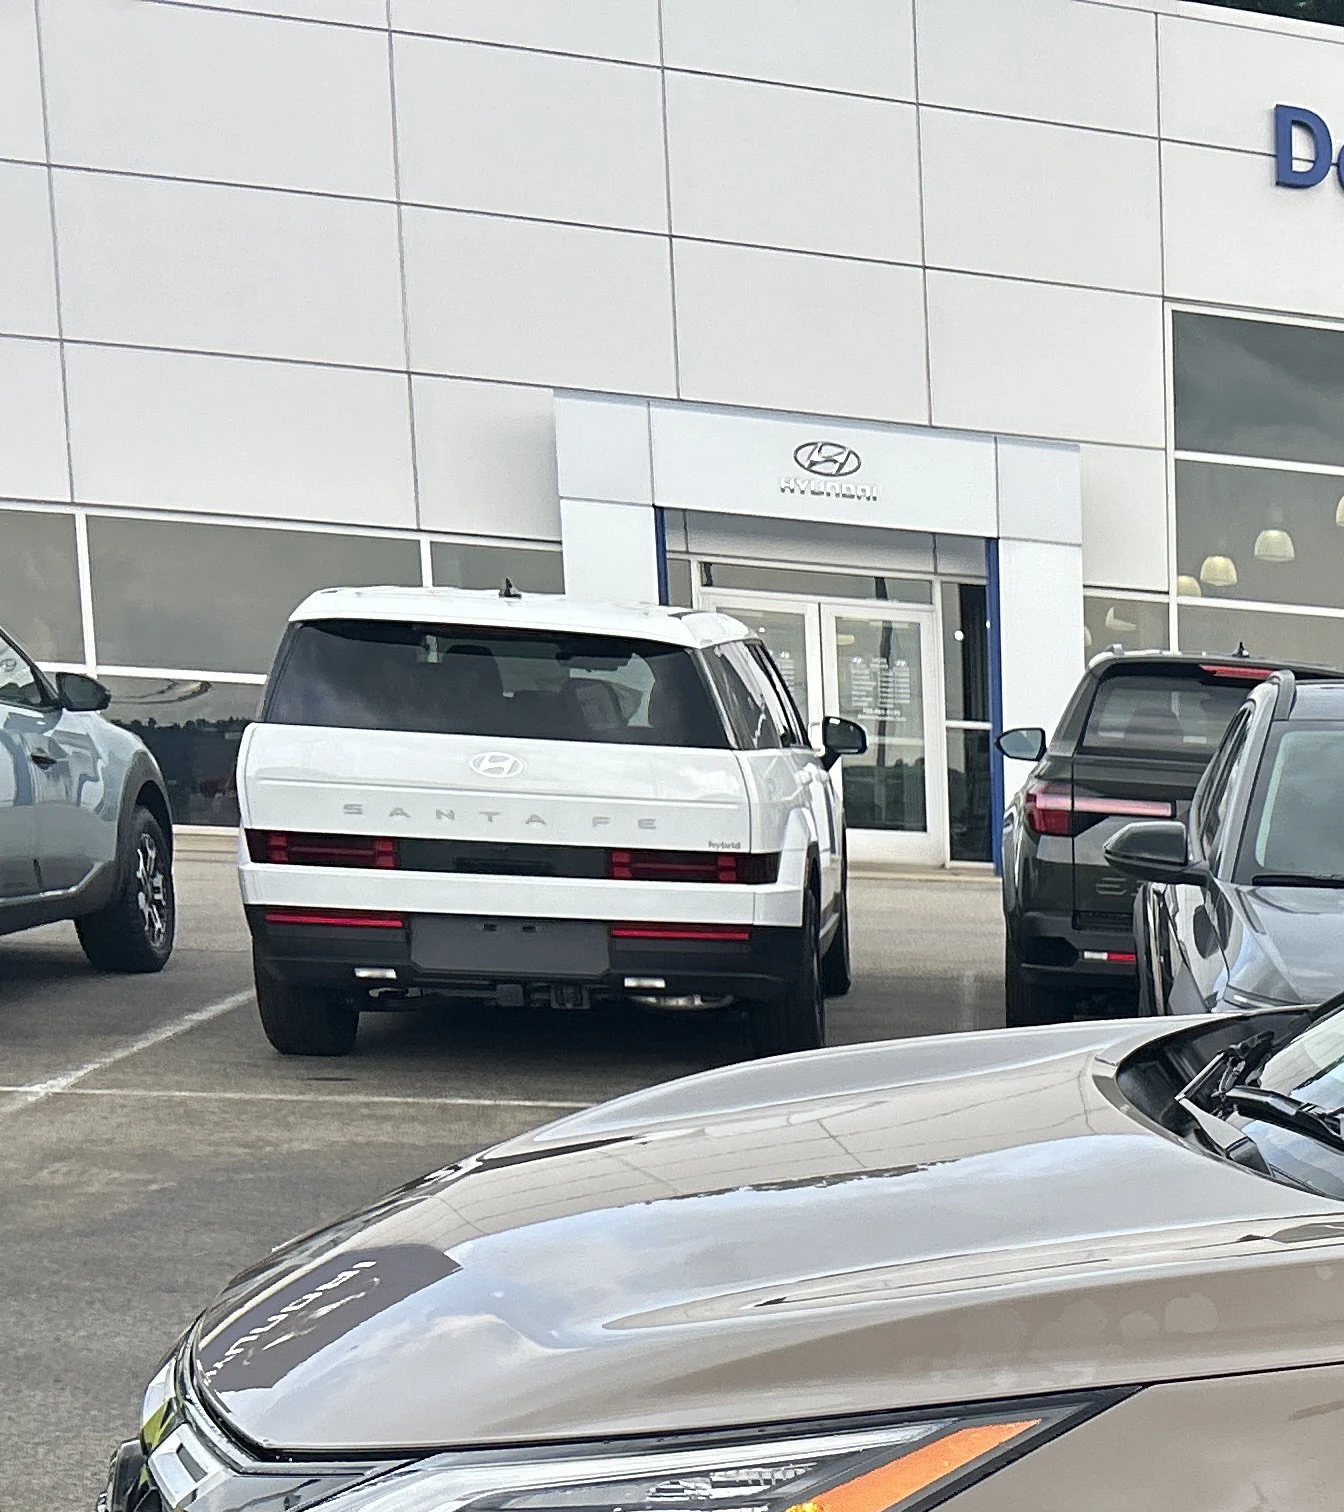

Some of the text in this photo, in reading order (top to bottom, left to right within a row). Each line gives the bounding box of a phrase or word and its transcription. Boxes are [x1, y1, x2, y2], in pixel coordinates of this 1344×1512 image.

[780, 477, 878, 502] HYUNDAI
[342, 803, 658, 831] SANTA FE
